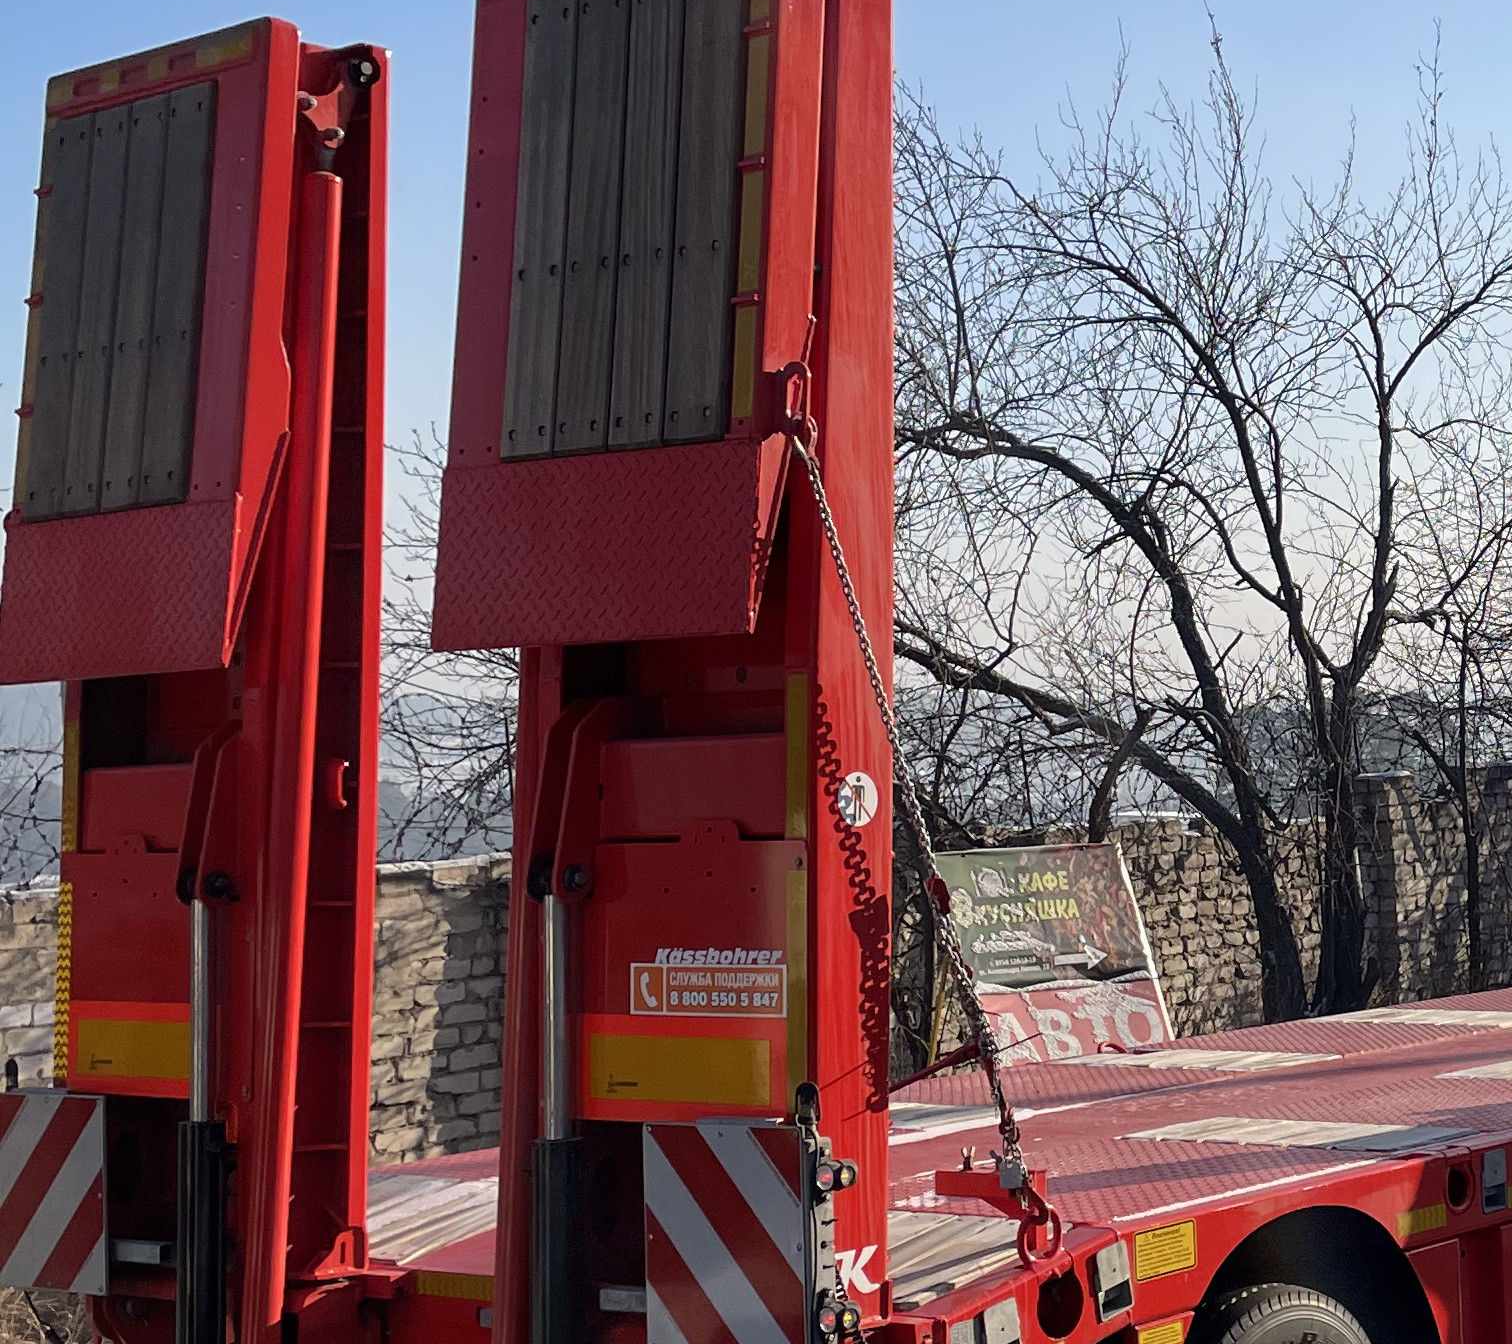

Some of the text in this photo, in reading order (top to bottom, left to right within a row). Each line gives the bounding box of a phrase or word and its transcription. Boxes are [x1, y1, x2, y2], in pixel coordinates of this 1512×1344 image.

[1018, 871, 1070, 893] КАФЕ
[654, 947, 783, 965] Kässbohrer
[669, 972, 780, 988] СЛУЖБА ПОДДЕРЖКИ
[669, 991, 779, 1007] 8 800 550 5 847
